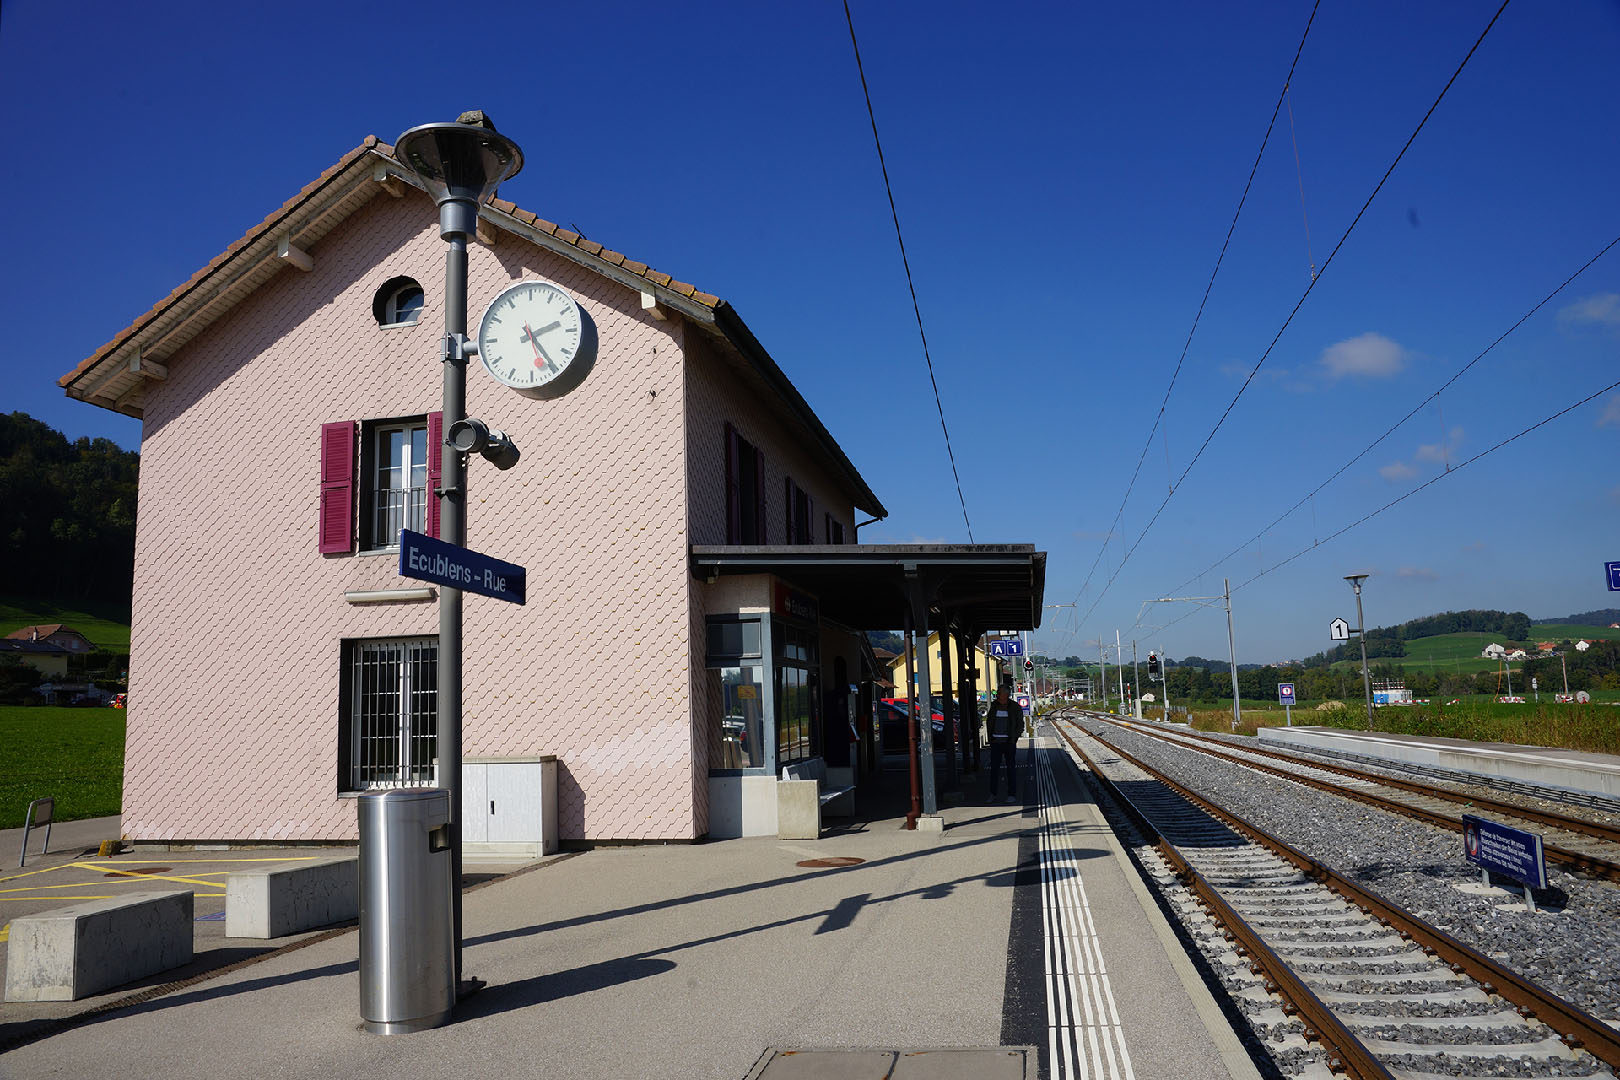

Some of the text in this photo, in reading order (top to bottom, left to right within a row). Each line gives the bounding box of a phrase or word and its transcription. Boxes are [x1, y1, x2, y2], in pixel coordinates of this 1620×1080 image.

[409, 546, 472, 584] Ecublens
[484, 568, 506, 592] Rue
[1336, 624, 1342, 637] 1
[995, 645, 1003, 654] A
[1011, 644, 1017, 653] 1
